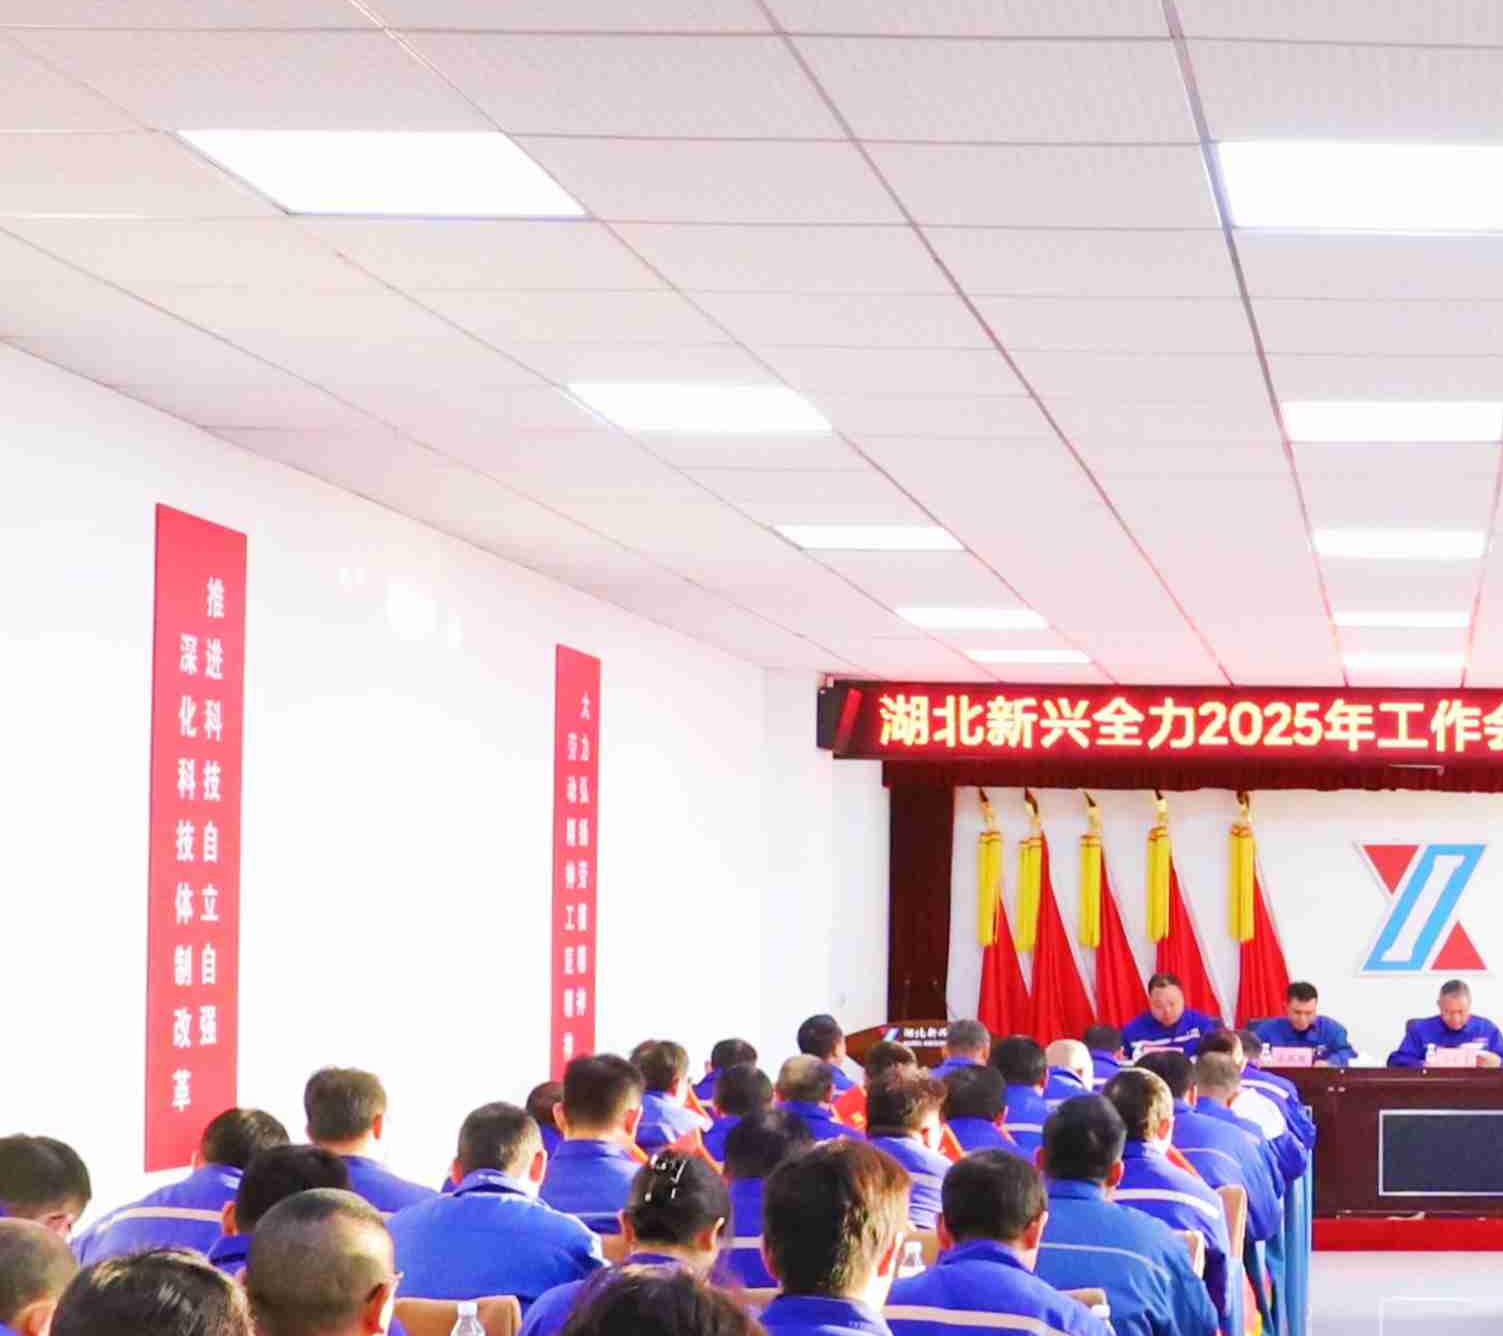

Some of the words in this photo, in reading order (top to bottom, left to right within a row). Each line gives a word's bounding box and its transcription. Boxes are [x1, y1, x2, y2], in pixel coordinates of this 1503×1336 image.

[171, 633, 199, 1112] 深化科技体制改革
[198, 576, 226, 1046] 推进科技自立自强
